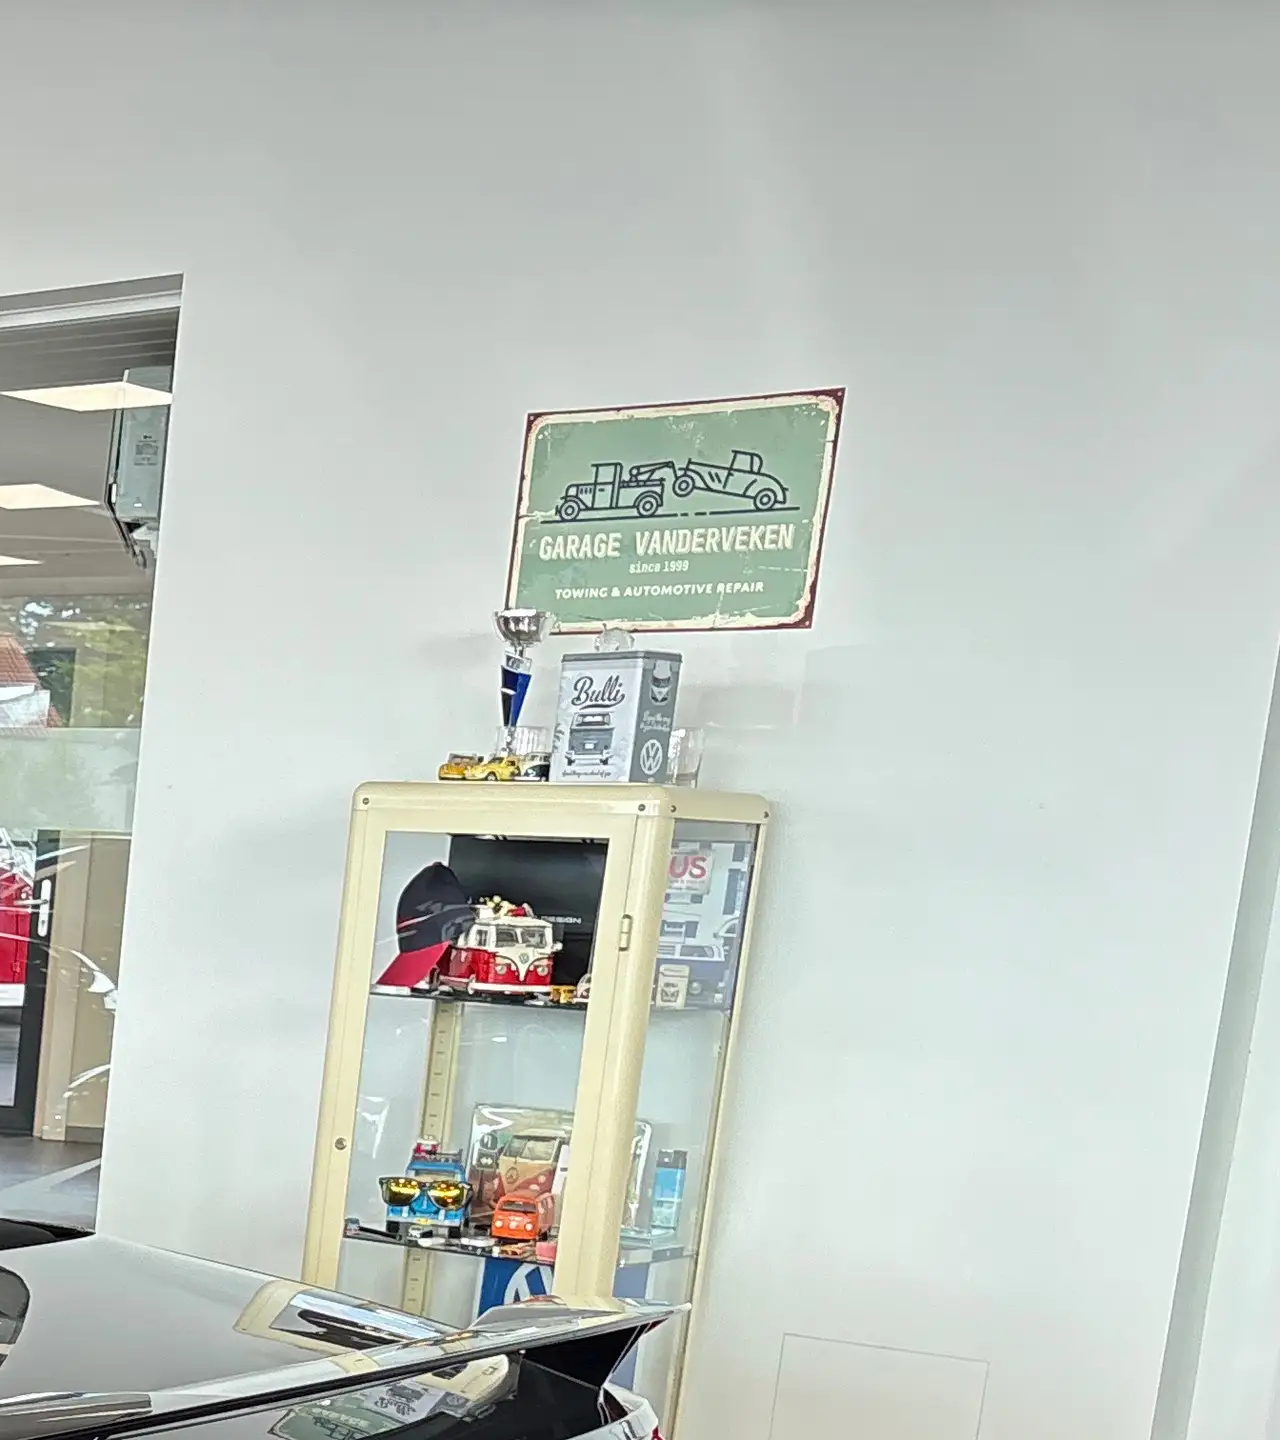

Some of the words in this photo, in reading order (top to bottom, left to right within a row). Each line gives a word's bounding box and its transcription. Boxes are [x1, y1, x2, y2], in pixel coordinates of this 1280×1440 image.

[539, 532, 622, 560] GARAGE
[635, 524, 796, 556] VANDERVEKEN
[629, 561, 660, 574] since
[663, 560, 690, 572] 1999
[555, 587, 608, 600] TOWING
[611, 586, 621, 597] &
[623, 583, 713, 597] AUTOMOTIVE
[716, 581, 765, 594] REPAIR
[571, 675, 626, 709] Bulli
